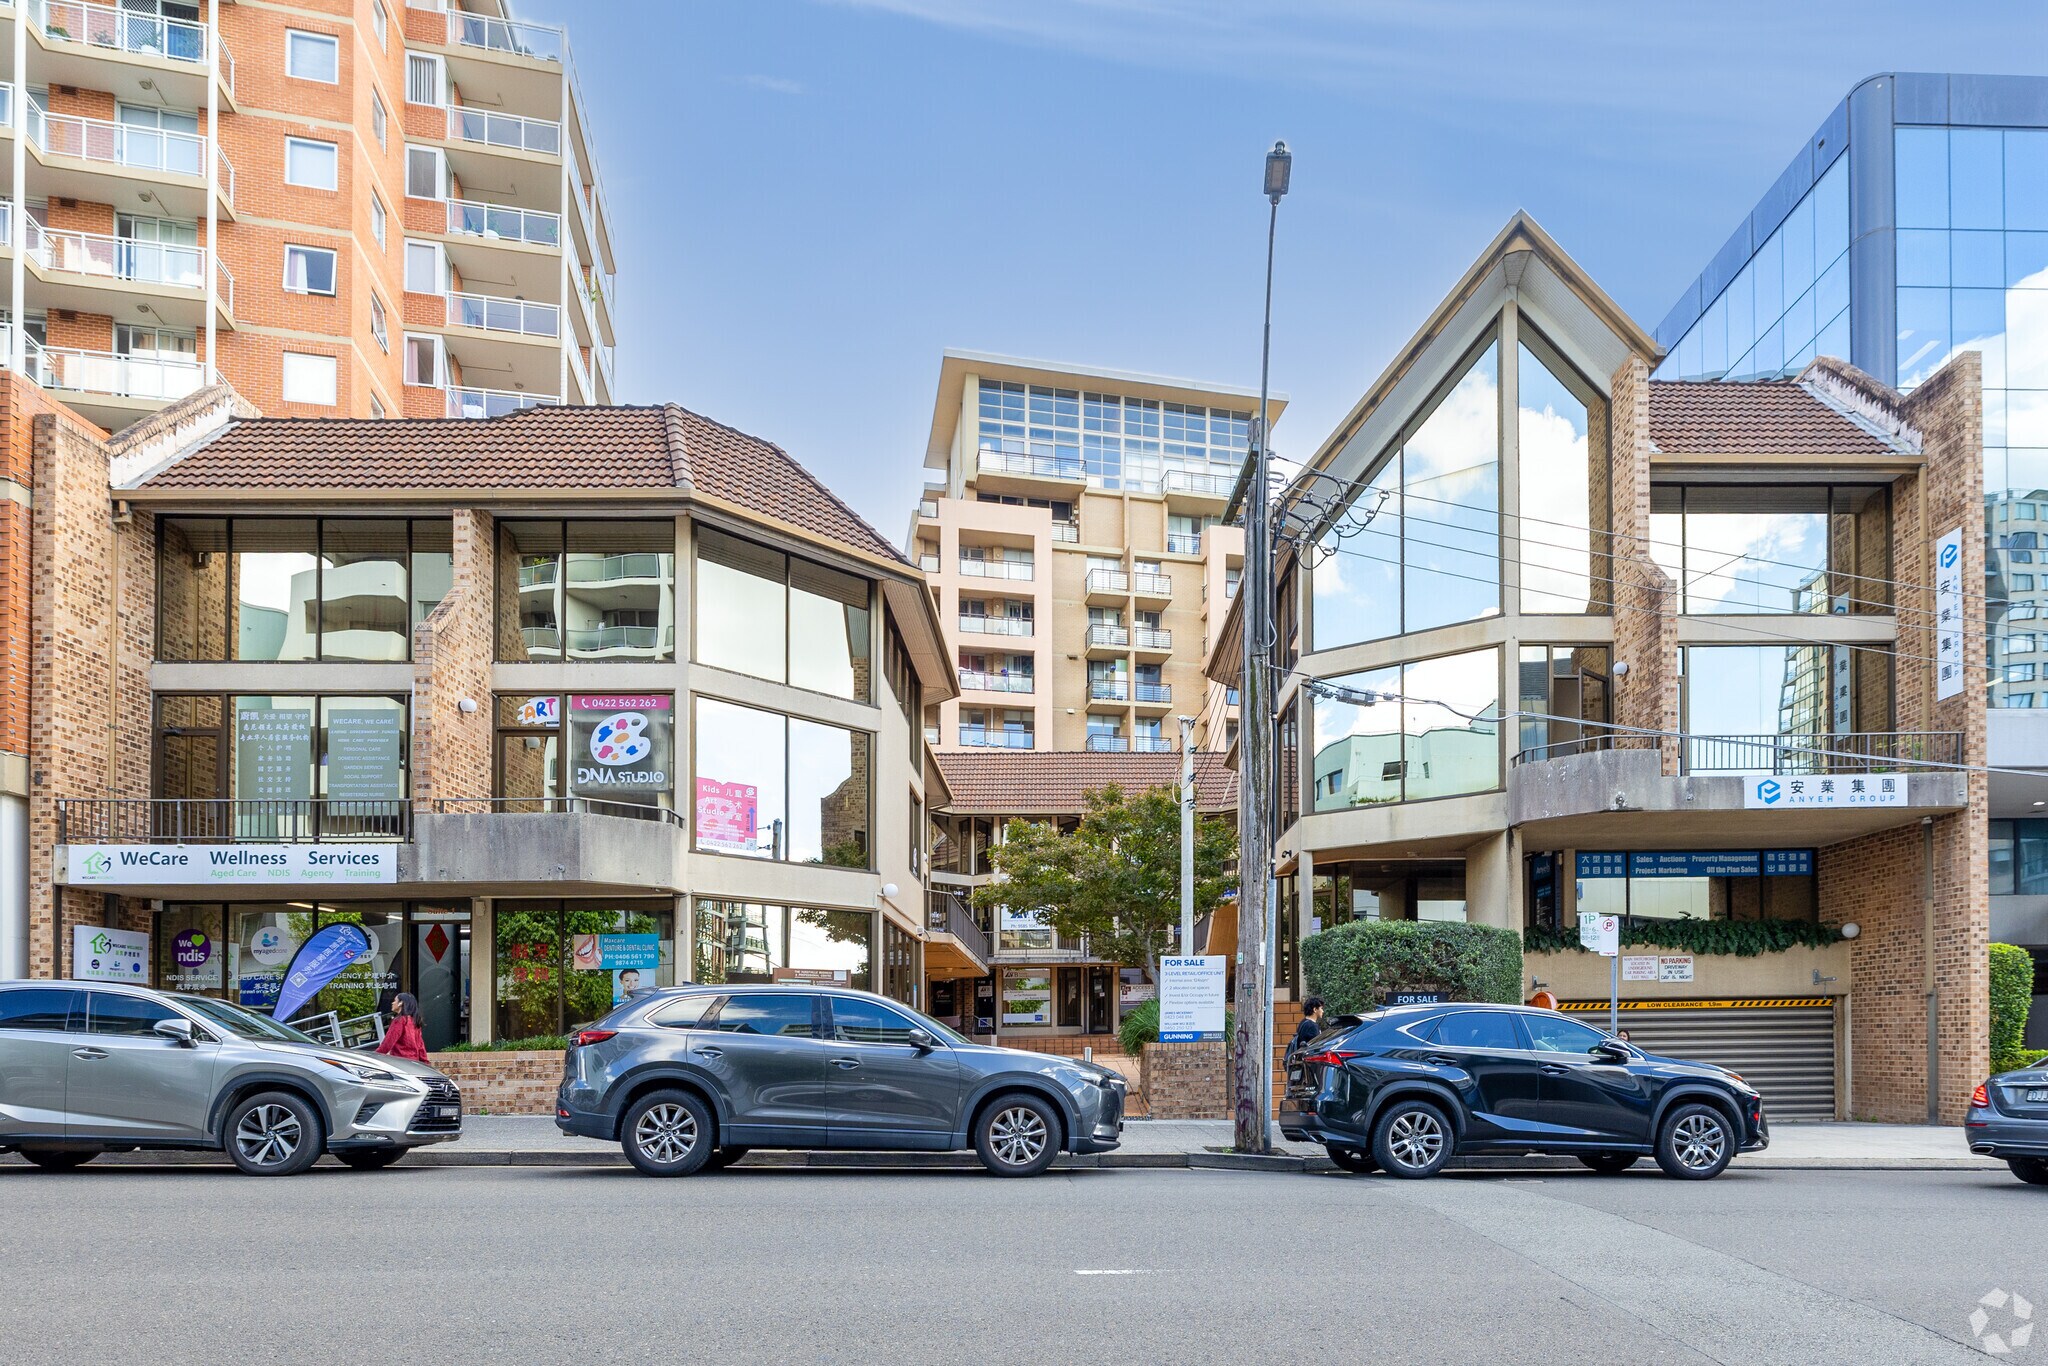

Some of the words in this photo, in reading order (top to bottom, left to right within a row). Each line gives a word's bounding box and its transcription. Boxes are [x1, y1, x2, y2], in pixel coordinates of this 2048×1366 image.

[592, 698, 616, 707] 0422
[619, 698, 637, 707] 562
[639, 698, 657, 707] 262
[524, 697, 556, 720] ART
[577, 768, 616, 784] DNA
[618, 771, 665, 783] STUDIO
[702, 784, 720, 794] Kids
[1790, 779, 1895, 794] 安業集團
[1789, 795, 1834, 803] ANYEH
[1850, 795, 1895, 803] GROUP
[698, 806, 725, 816] Studio
[120, 851, 189, 866] WeCare
[210, 850, 287, 865] Wellness
[308, 851, 379, 865] Services
[1692, 855, 1718, 863] Property
[210, 869, 235, 878] Aged
[237, 869, 257, 877] Care
[267, 869, 291, 877] NDIS
[300, 869, 334, 878] Agency
[344, 869, 381, 878] Training
[1635, 867, 1657, 875] Project
[1658, 867, 1688, 875] Marketing
[1584, 914, 1596, 925] 1P
[178, 940, 192, 948] We
[177, 949, 205, 962] ndis
[1164, 959, 1182, 967] FOR
[1184, 959, 1205, 967] SALE
[363, 972, 395, 980] 护理中介
[1397, 996, 1414, 1004] FOR
